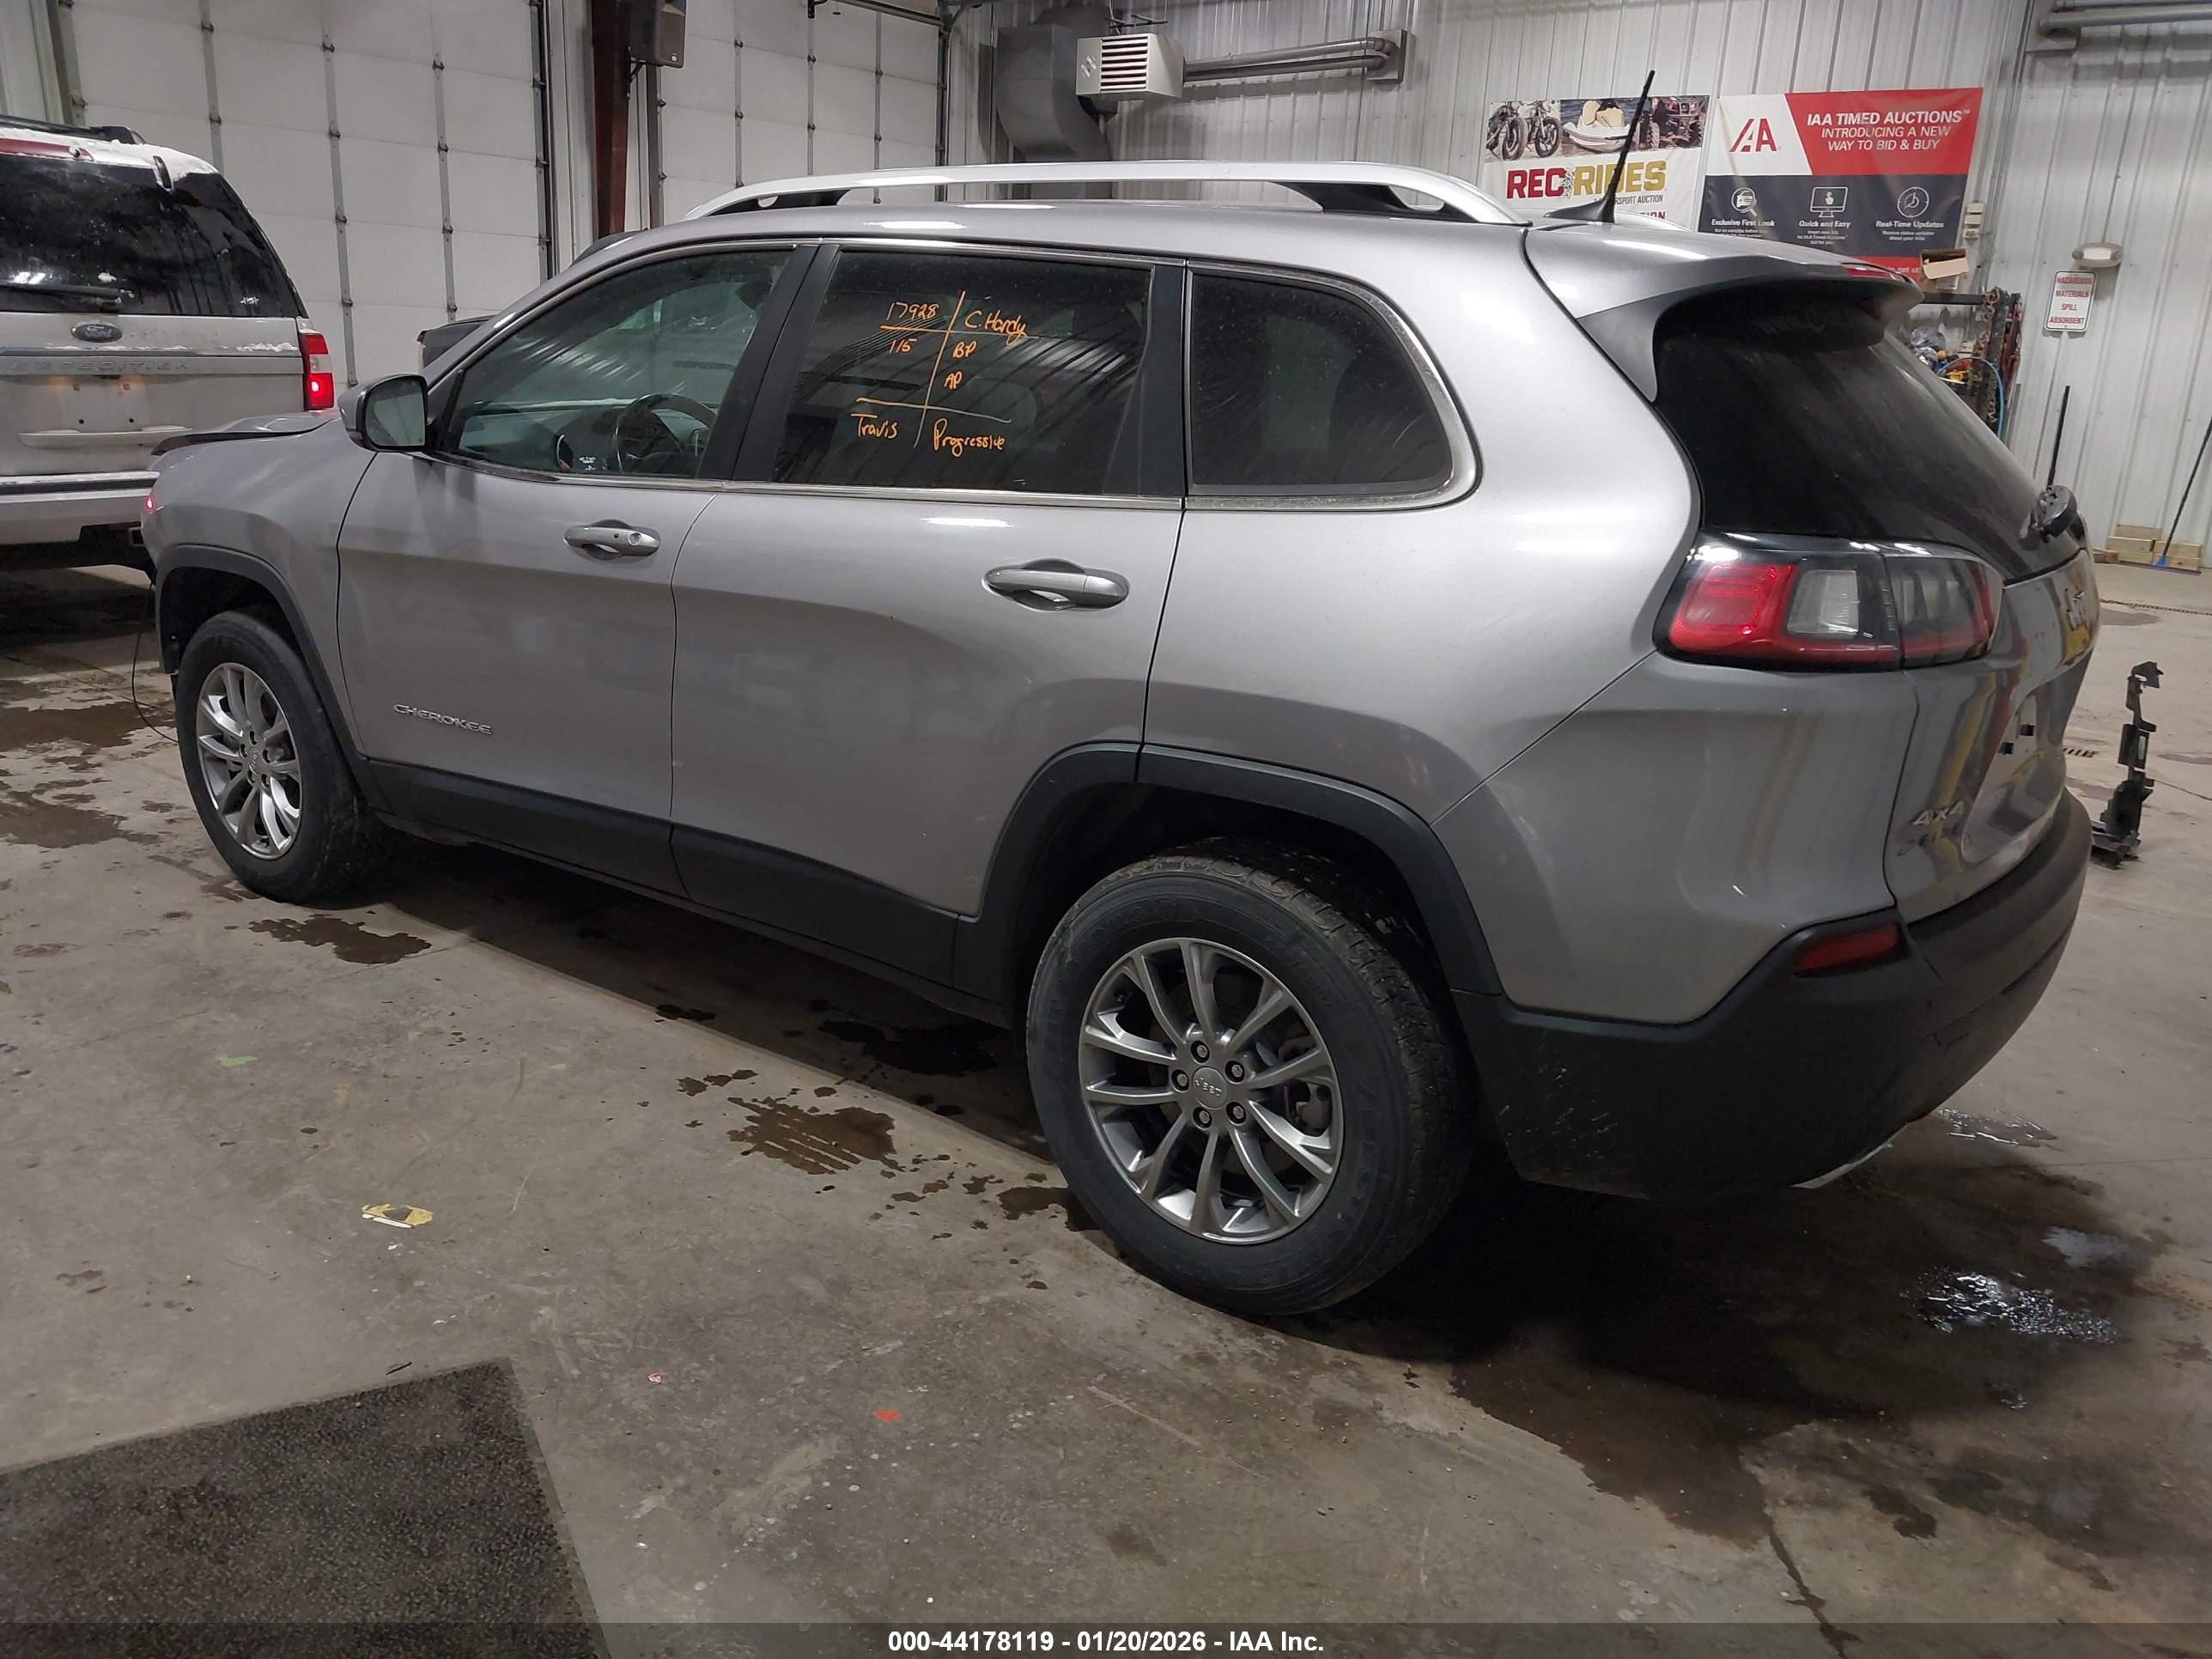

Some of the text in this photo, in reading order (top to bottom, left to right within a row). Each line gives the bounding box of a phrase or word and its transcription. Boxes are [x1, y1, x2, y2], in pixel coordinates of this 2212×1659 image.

[1807, 112, 1832, 126] IAA
[1836, 112, 1881, 125] TIMED
[1821, 125, 1951, 138] INTRODUCING A NEW
[1827, 139, 1941, 151] WAY TO BID & BUY
[1507, 167, 1566, 198] REC
[1637, 194, 1663, 204] AUCTION
[886, 301, 939, 321] 17928
[952, 340, 977, 358] BP
[851, 413, 898, 439] Travis
[393, 703, 493, 735] CHEROKEE
